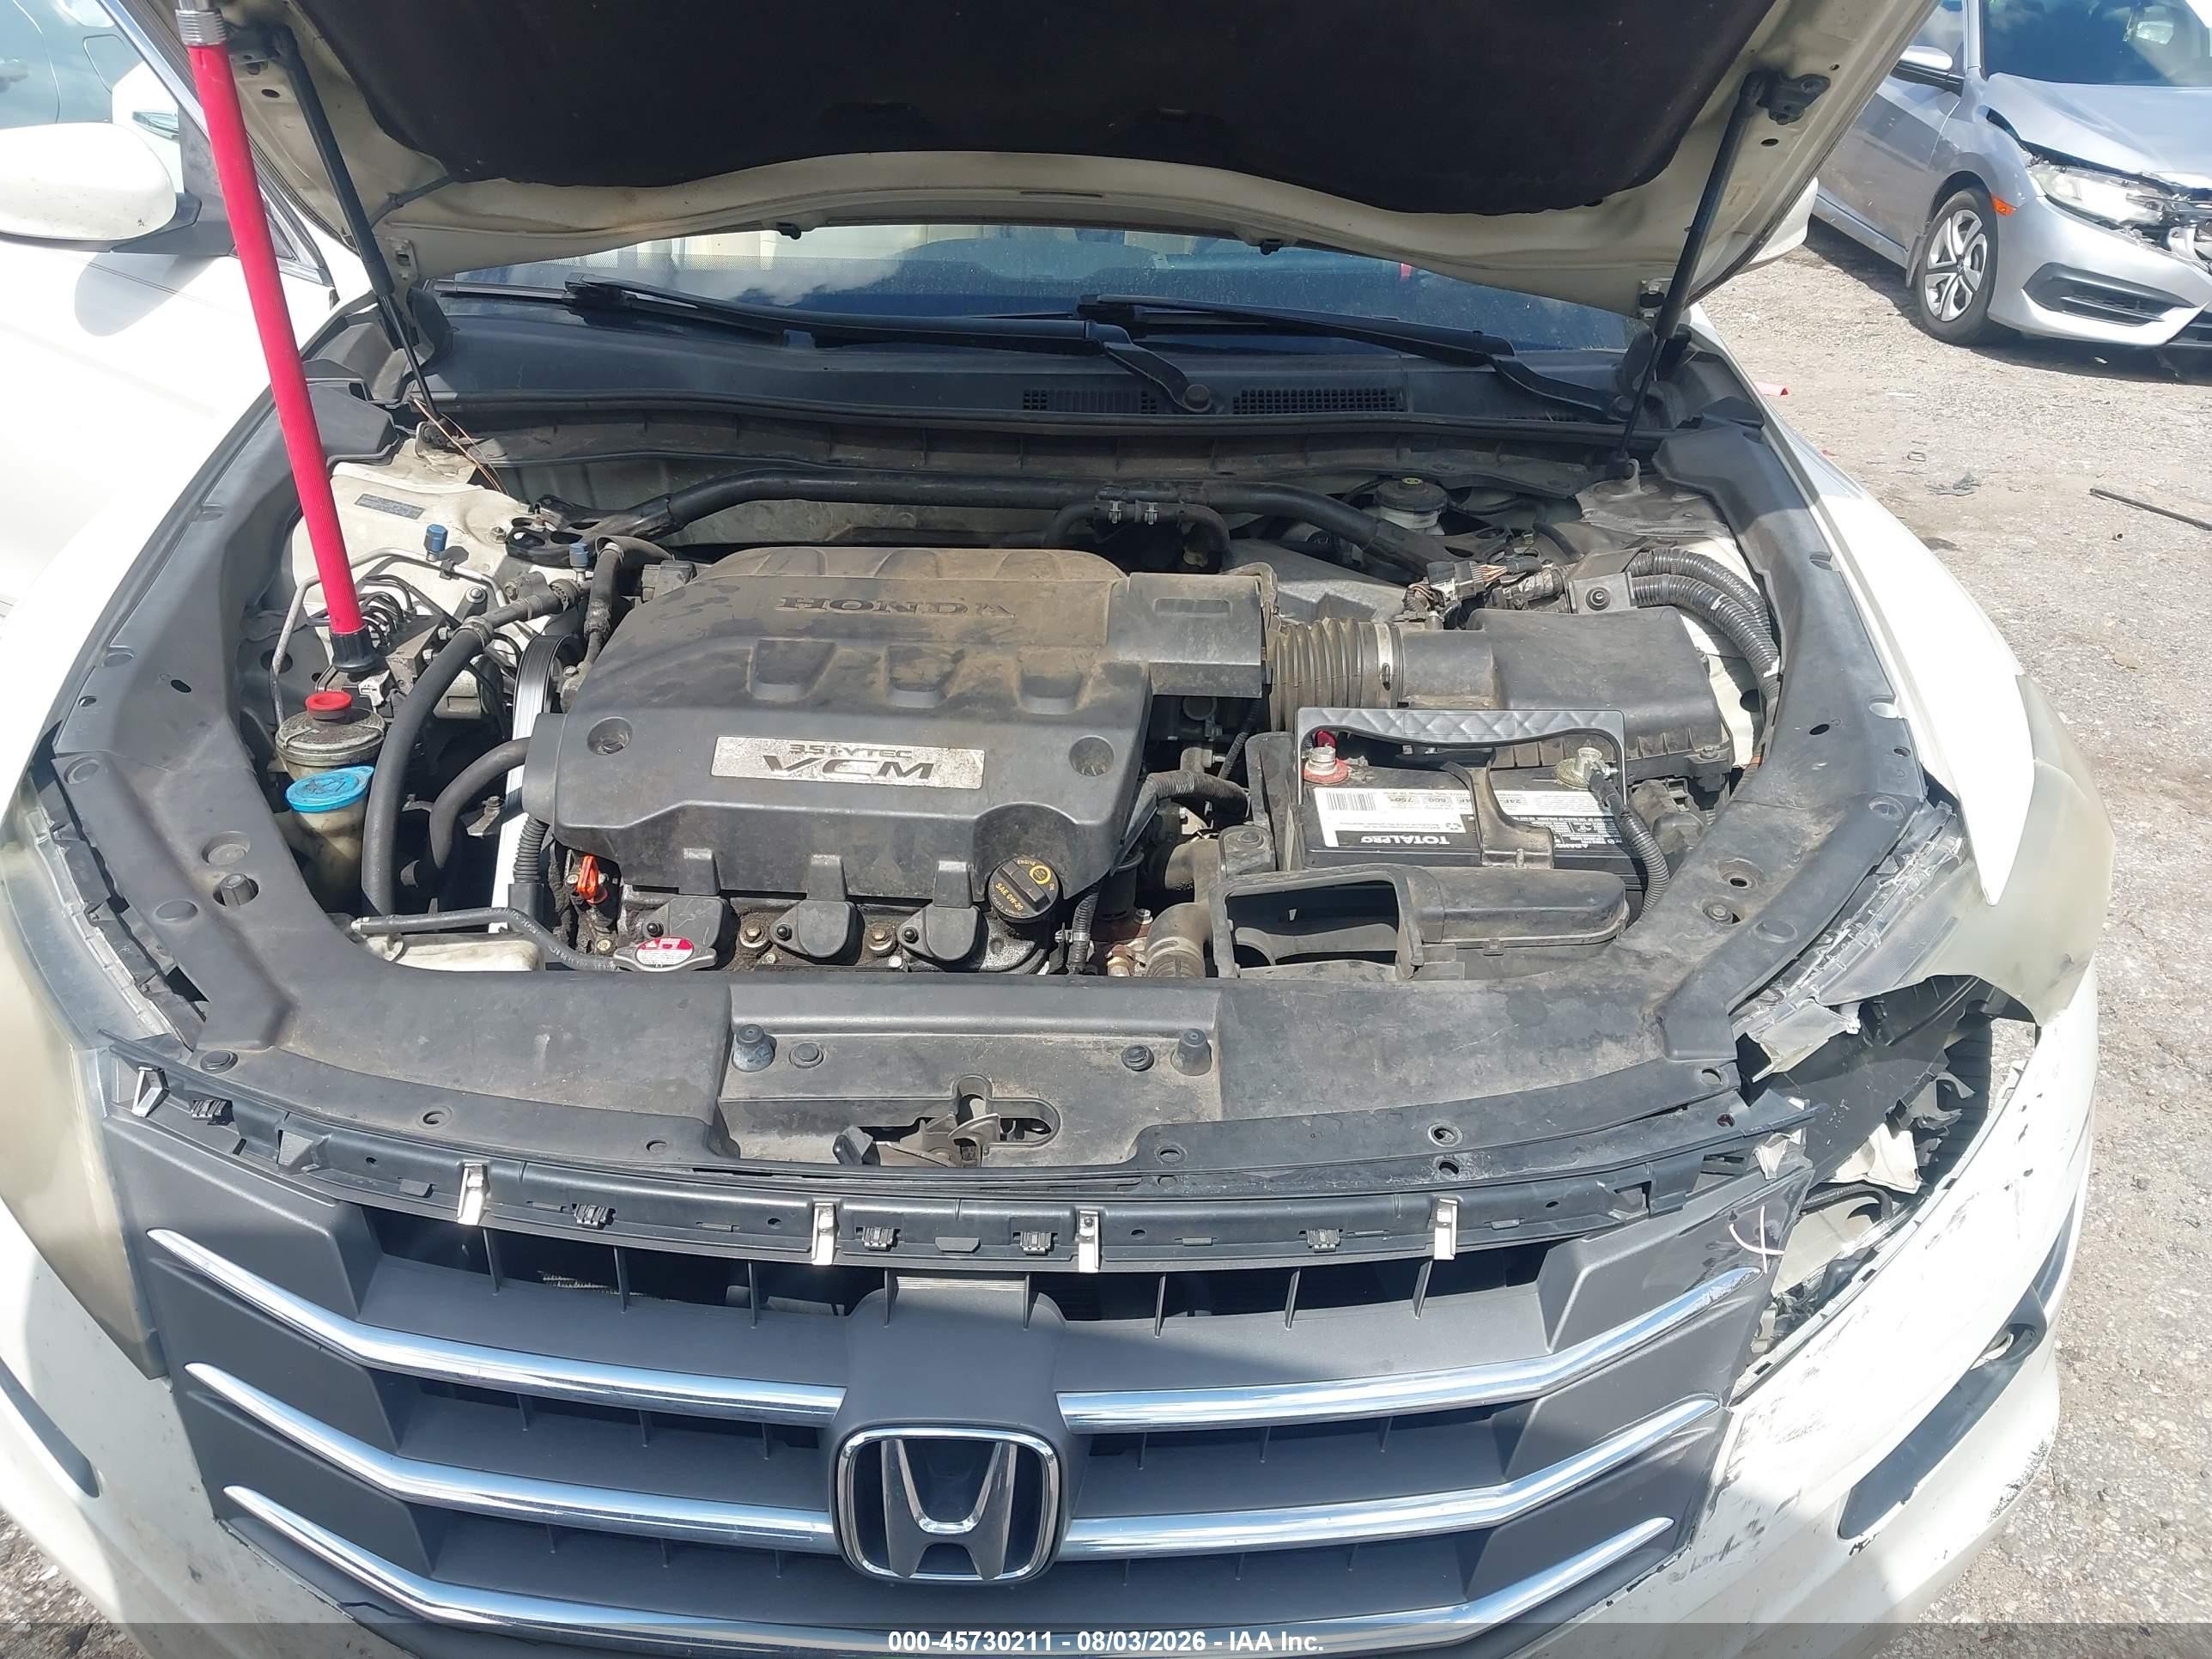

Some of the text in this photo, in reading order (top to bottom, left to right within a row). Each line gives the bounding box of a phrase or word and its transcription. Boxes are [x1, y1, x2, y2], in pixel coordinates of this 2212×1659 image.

[775, 597, 1017, 618] HONDA
[762, 755, 934, 781] VCM
[1360, 836, 1450, 845] TOTALPRO
[995, 882, 1009, 896] SAE
[1006, 892, 1024, 911] 0W-20
